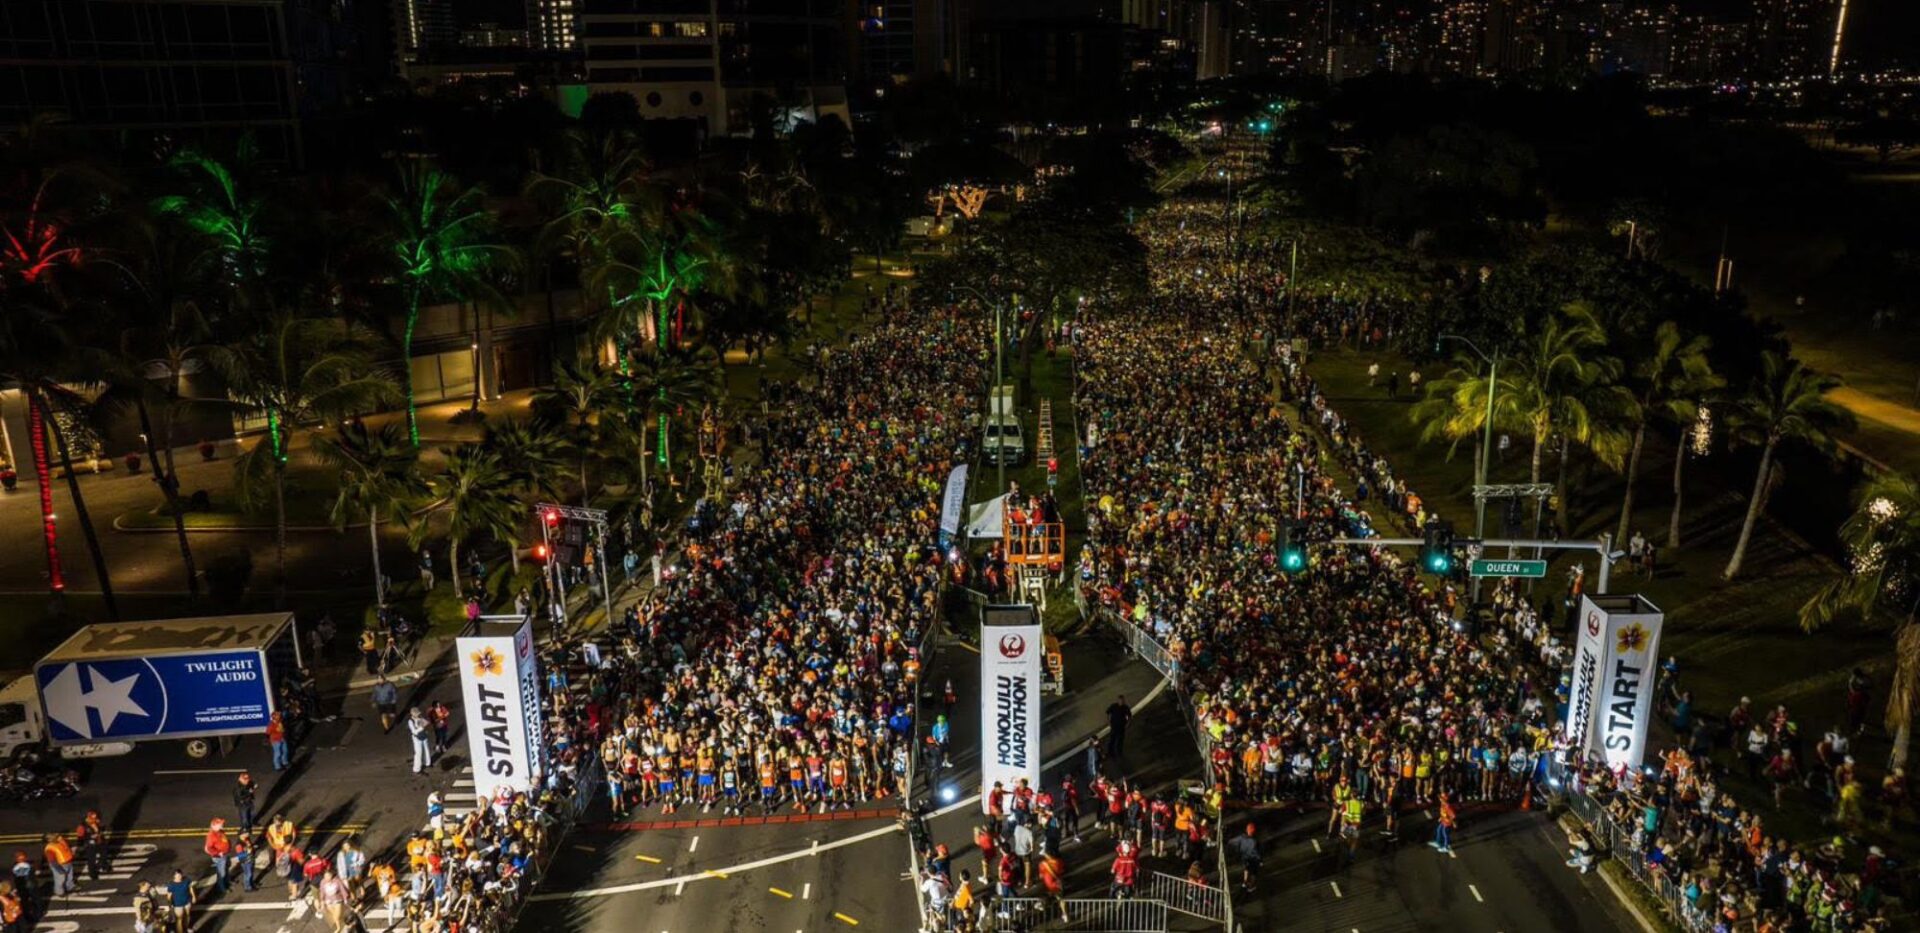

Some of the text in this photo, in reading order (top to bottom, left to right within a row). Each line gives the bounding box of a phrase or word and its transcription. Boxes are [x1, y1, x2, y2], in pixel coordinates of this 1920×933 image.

[1487, 563, 1520, 573] QUEEN
[184, 659, 254, 673] TWILIGHT
[215, 671, 257, 683] AUDIO
[195, 713, 264, 723] TWILIGHTAUDIO.COM
[477, 683, 514, 778] START
[997, 675, 1012, 766] HONOLULU
[1013, 676, 1027, 769] MARATHON
[1605, 659, 1641, 751] START
